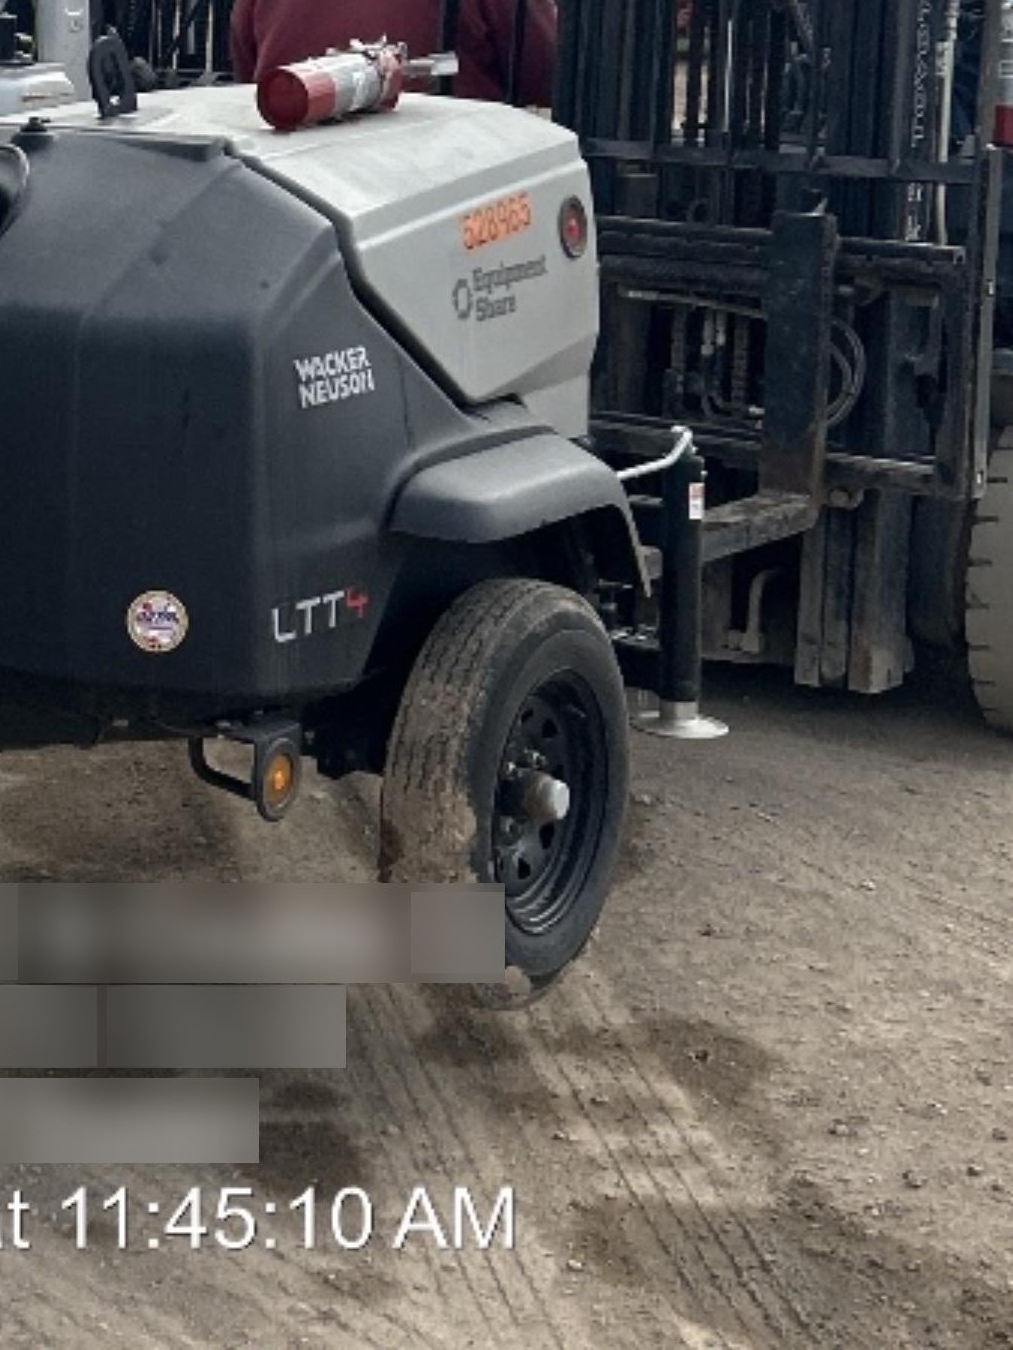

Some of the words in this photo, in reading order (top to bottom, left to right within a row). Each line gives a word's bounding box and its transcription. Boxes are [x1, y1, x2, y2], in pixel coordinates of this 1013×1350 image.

[472, 254, 548, 296] Equipment
[475, 294, 517, 322] Share
[292, 345, 372, 383] WACKER
[298, 368, 375, 409] NEUSON
[271, 587, 369, 644] LTT4
